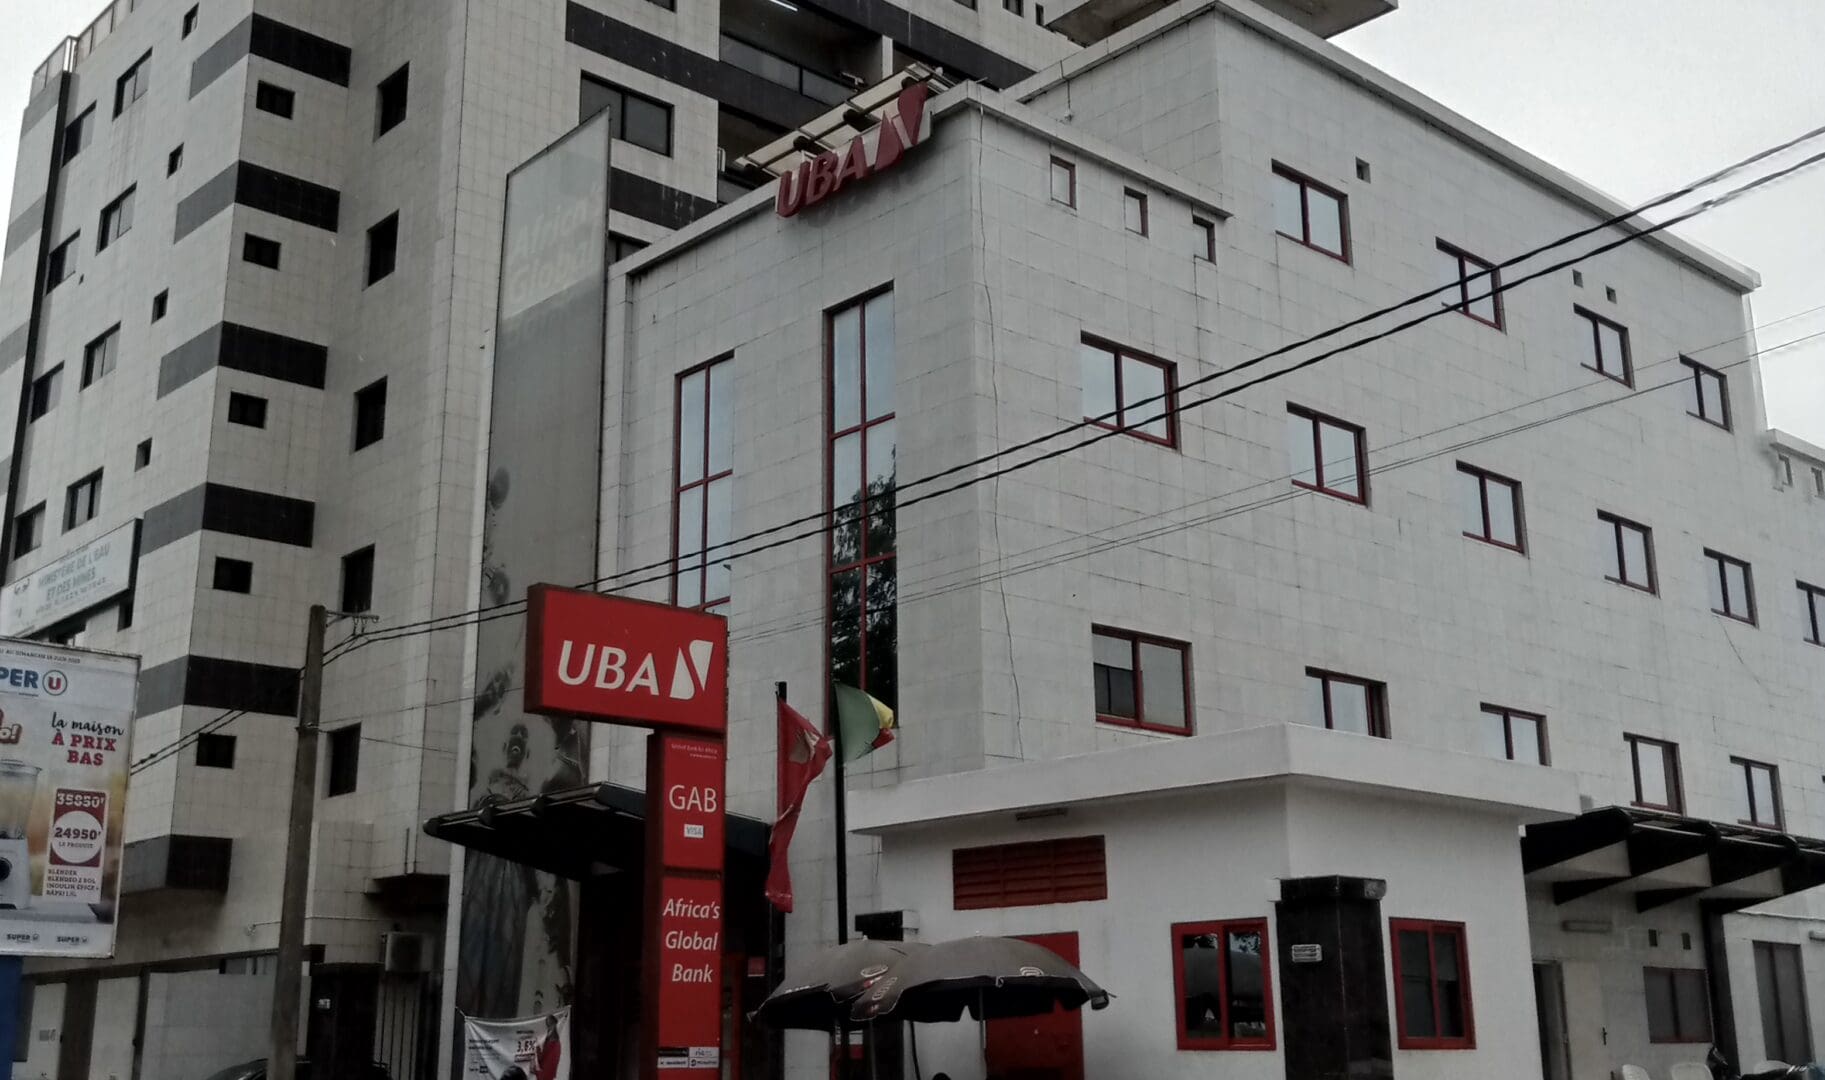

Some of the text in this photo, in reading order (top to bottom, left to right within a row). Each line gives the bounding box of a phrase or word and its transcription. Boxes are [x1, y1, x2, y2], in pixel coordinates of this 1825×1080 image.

[777, 135, 870, 217] UBA
[558, 640, 660, 696] UBA
[51, 711, 124, 736] la maison
[51, 728, 116, 752] À PRIX
[67, 750, 103, 766] BAS
[669, 784, 717, 812] GAB
[686, 826, 704, 836] VISA
[662, 897, 720, 919] Africa's
[666, 930, 718, 951] Global
[672, 963, 713, 983] Bank
